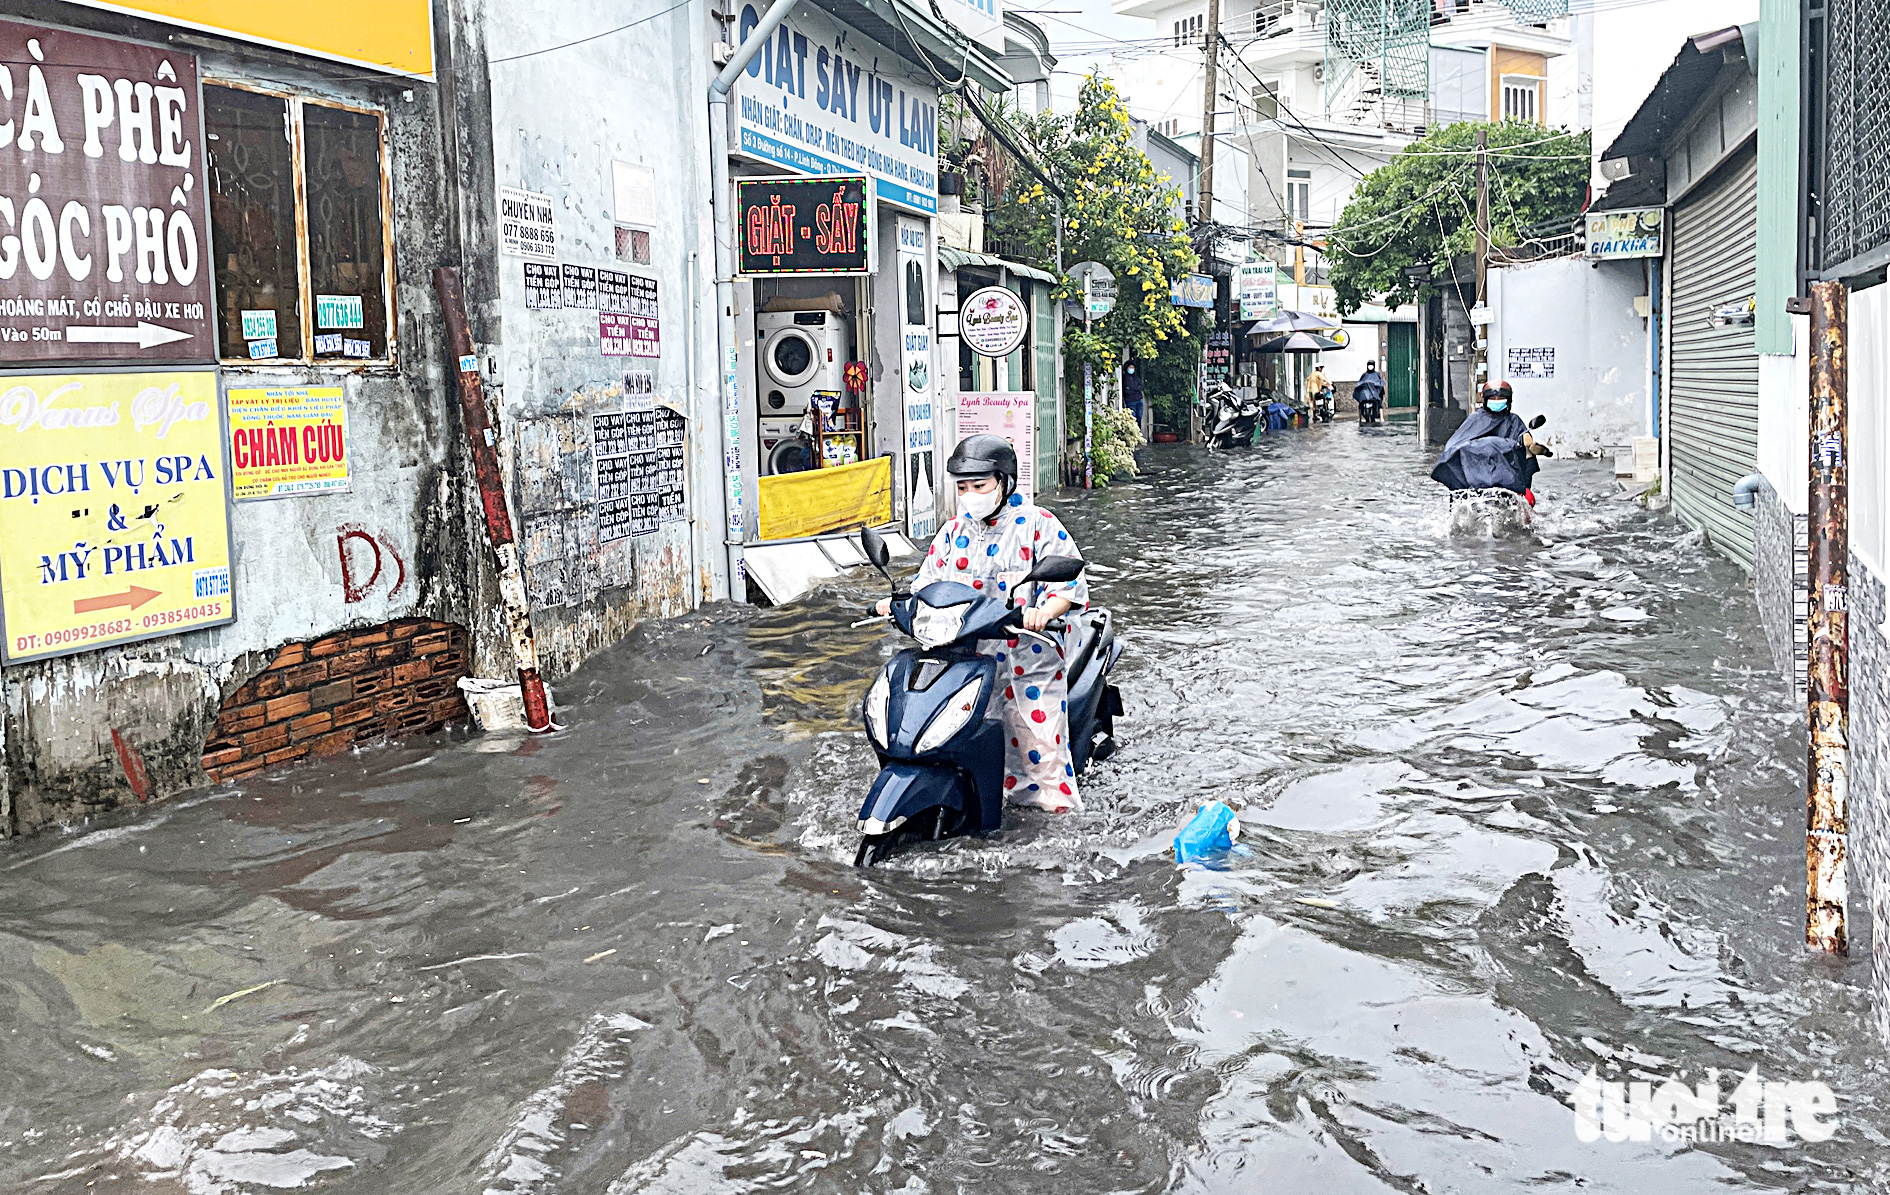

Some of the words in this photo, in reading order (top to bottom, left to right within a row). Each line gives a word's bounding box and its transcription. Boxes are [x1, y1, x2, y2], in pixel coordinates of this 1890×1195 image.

[817, 30, 861, 122] SẤY
[868, 57, 893, 138] ÚT
[900, 90, 935, 157] LAN
[77, 59, 191, 169] PHÊ
[742, 95, 763, 128] NHẬN
[841, 138, 855, 162] THEO
[753, 136, 757, 149] 3
[785, 147, 791, 161] 14
[102, 172, 198, 286] PHỐ
[748, 194, 796, 265] GIẶT
[816, 185, 859, 254] SẤY
[503, 223, 518, 237] 077
[520, 226, 539, 241] 8888
[540, 229, 555, 243] 656
[526, 264, 542, 275] CHO
[544, 265, 557, 276] VAY
[564, 265, 579, 276] CHO
[580, 267, 593, 278] VAY
[600, 270, 613, 281] CHO
[615, 273, 626, 283] VAY
[631, 276, 644, 287] CHO
[645, 279, 655, 289] VAY
[48, 295, 80, 319] MÁT,
[84, 296, 101, 317] CÓ
[105, 294, 131, 317] CHỖ
[135, 298, 161, 320] ĐẬU
[165, 303, 180, 318] XE
[318, 302, 334, 327] 0977
[335, 303, 348, 327] 636
[349, 303, 362, 327] 444
[601, 315, 615, 324] CHO
[617, 316, 629, 325] VAY
[632, 317, 645, 327] CHO
[647, 318, 658, 328] VAY
[1, 327, 28, 341] Vào
[32, 327, 61, 340] 50m
[961, 397, 980, 408] Lynh
[983, 397, 1010, 408] Beauty
[1013, 397, 1028, 408] Spa
[0, 381, 120, 433] Venus
[130, 382, 211, 439] Spa
[594, 416, 609, 427] CHO
[610, 415, 624, 426] VAY
[626, 413, 640, 423] CHO
[641, 412, 654, 422] VAY
[234, 420, 299, 469] CHÂM
[303, 418, 344, 464] CỨU
[629, 454, 644, 465] CHO
[645, 453, 656, 463] VAY
[657, 449, 671, 458] CHO
[671, 447, 683, 457] VAY
[598, 460, 613, 471] CHO
[614, 459, 627, 469] VAY
[2, 463, 90, 504] DỊCH
[100, 459, 144, 494] VỤ
[155, 454, 215, 485] SPA
[659, 486, 671, 494] CHO
[672, 483, 683, 492] VAY
[600, 502, 613, 513] CHO
[615, 499, 628, 509] VAY
[631, 494, 645, 505] CHO
[646, 493, 658, 503] VAY
[107, 503, 128, 531] &
[41, 541, 92, 584] MỸ
[103, 524, 195, 575] PHẨM
[16, 632, 42, 651] ĐT:
[45, 618, 131, 648] 0909928682
[142, 602, 222, 628] 0938540435
